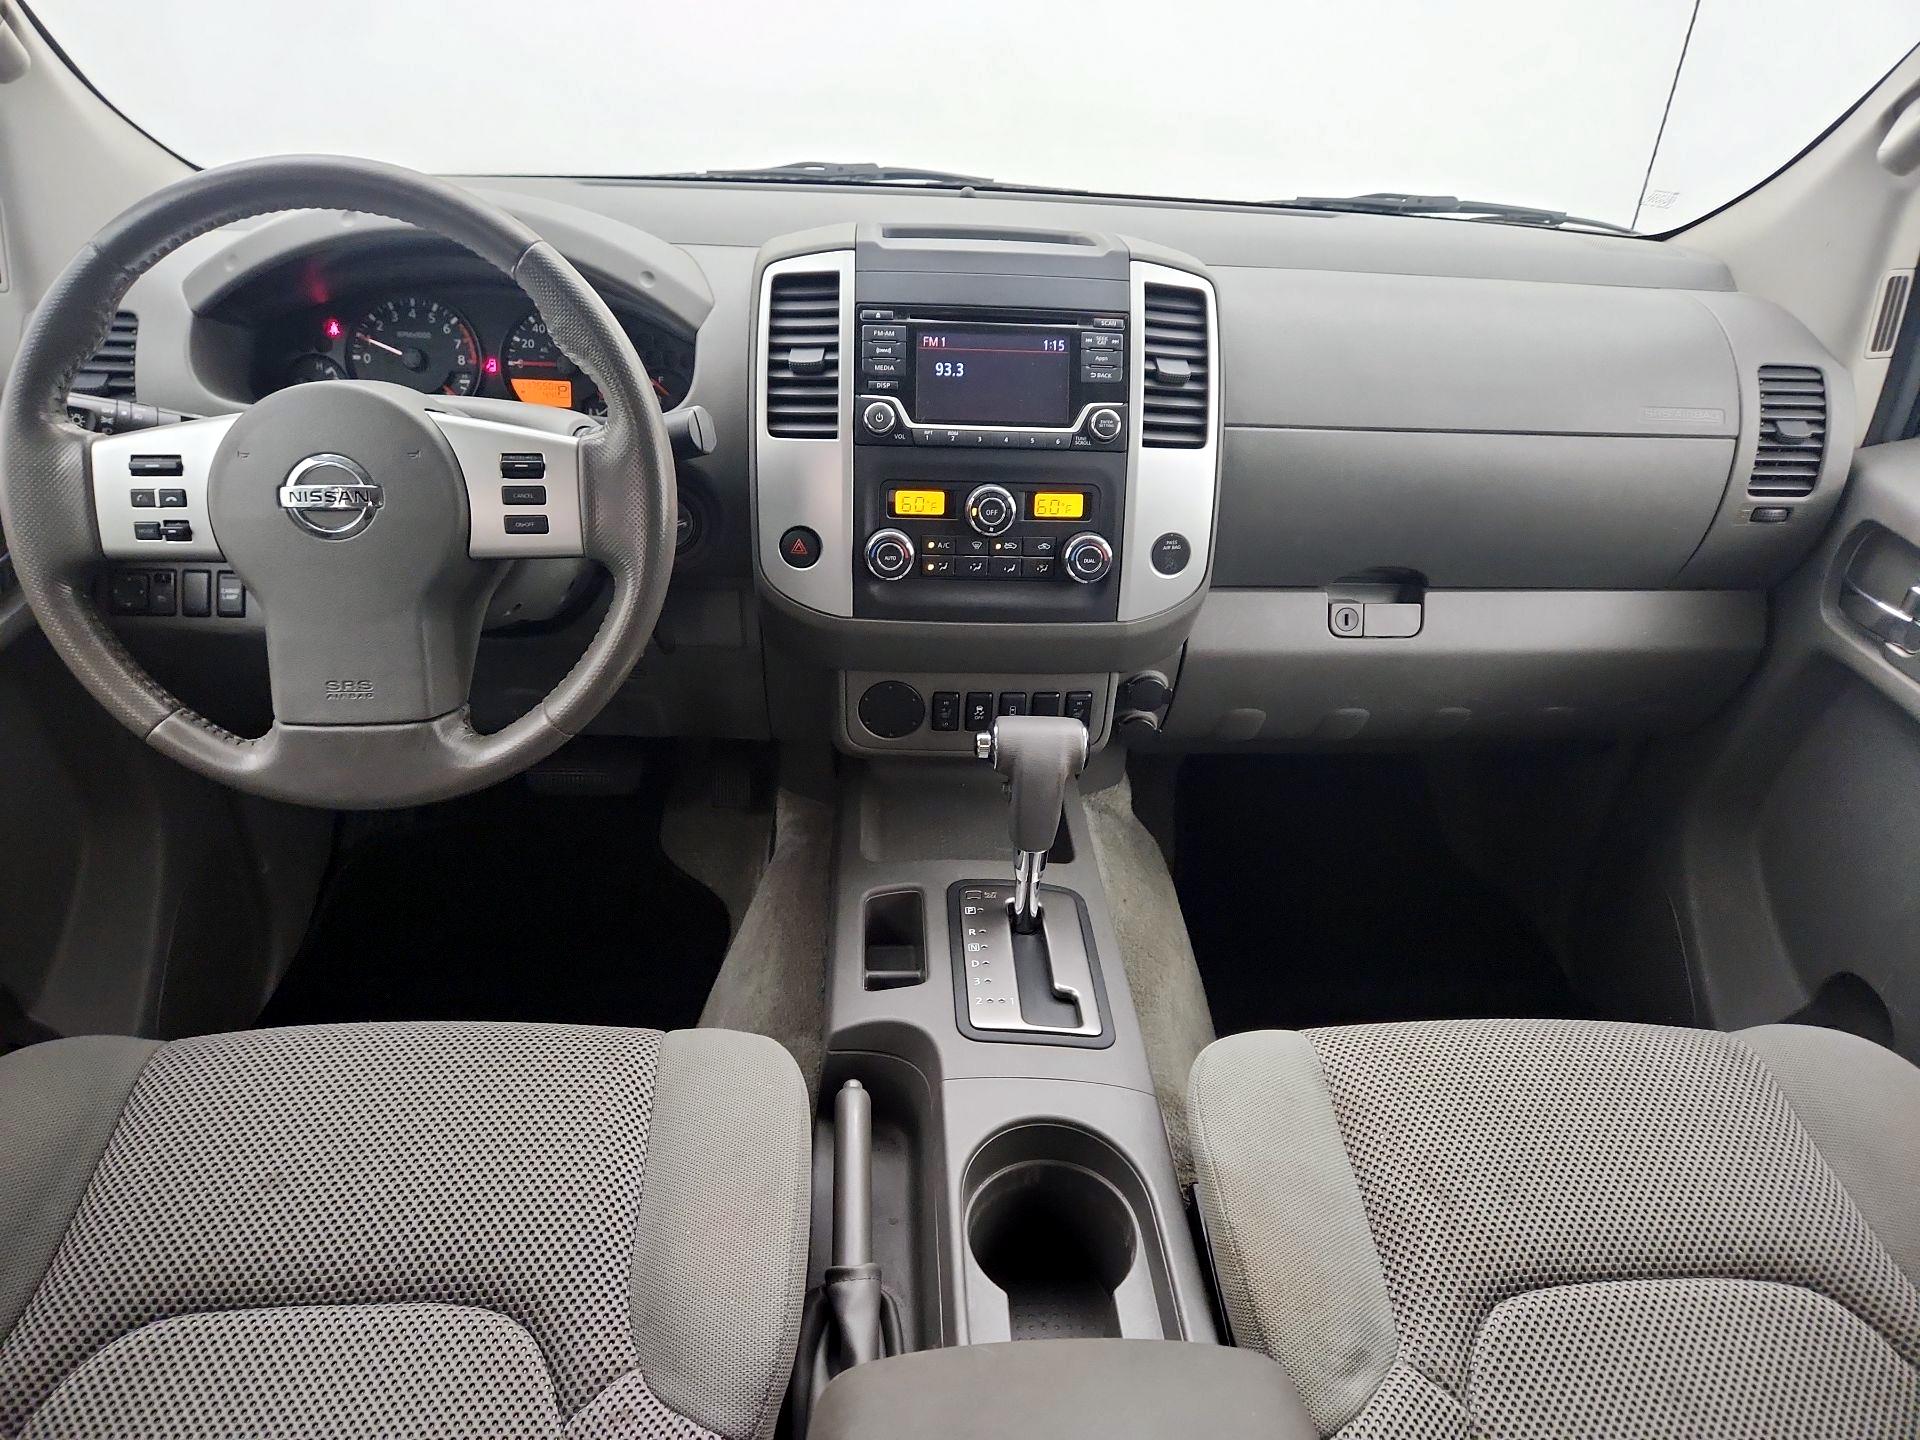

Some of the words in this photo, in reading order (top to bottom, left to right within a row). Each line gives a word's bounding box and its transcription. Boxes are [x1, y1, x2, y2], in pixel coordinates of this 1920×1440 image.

[391, 310, 399, 322] 3
[408, 308, 417, 318] 4
[428, 313, 436, 323] 5
[376, 320, 384, 332] 2
[442, 323, 451, 334] 6
[532, 323, 546, 334] 40
[453, 339, 461, 349] 7
[521, 339, 535, 348] 20
[923, 336, 939, 347] FM
[1043, 340, 1065, 351] 1:15
[363, 353, 371, 363] 0
[457, 355, 466, 366] 8
[935, 362, 964, 377] 93.3
[288, 490, 370, 503] NISSAN
[325, 680, 374, 691] SRS
[975, 997, 983, 1005] 2
